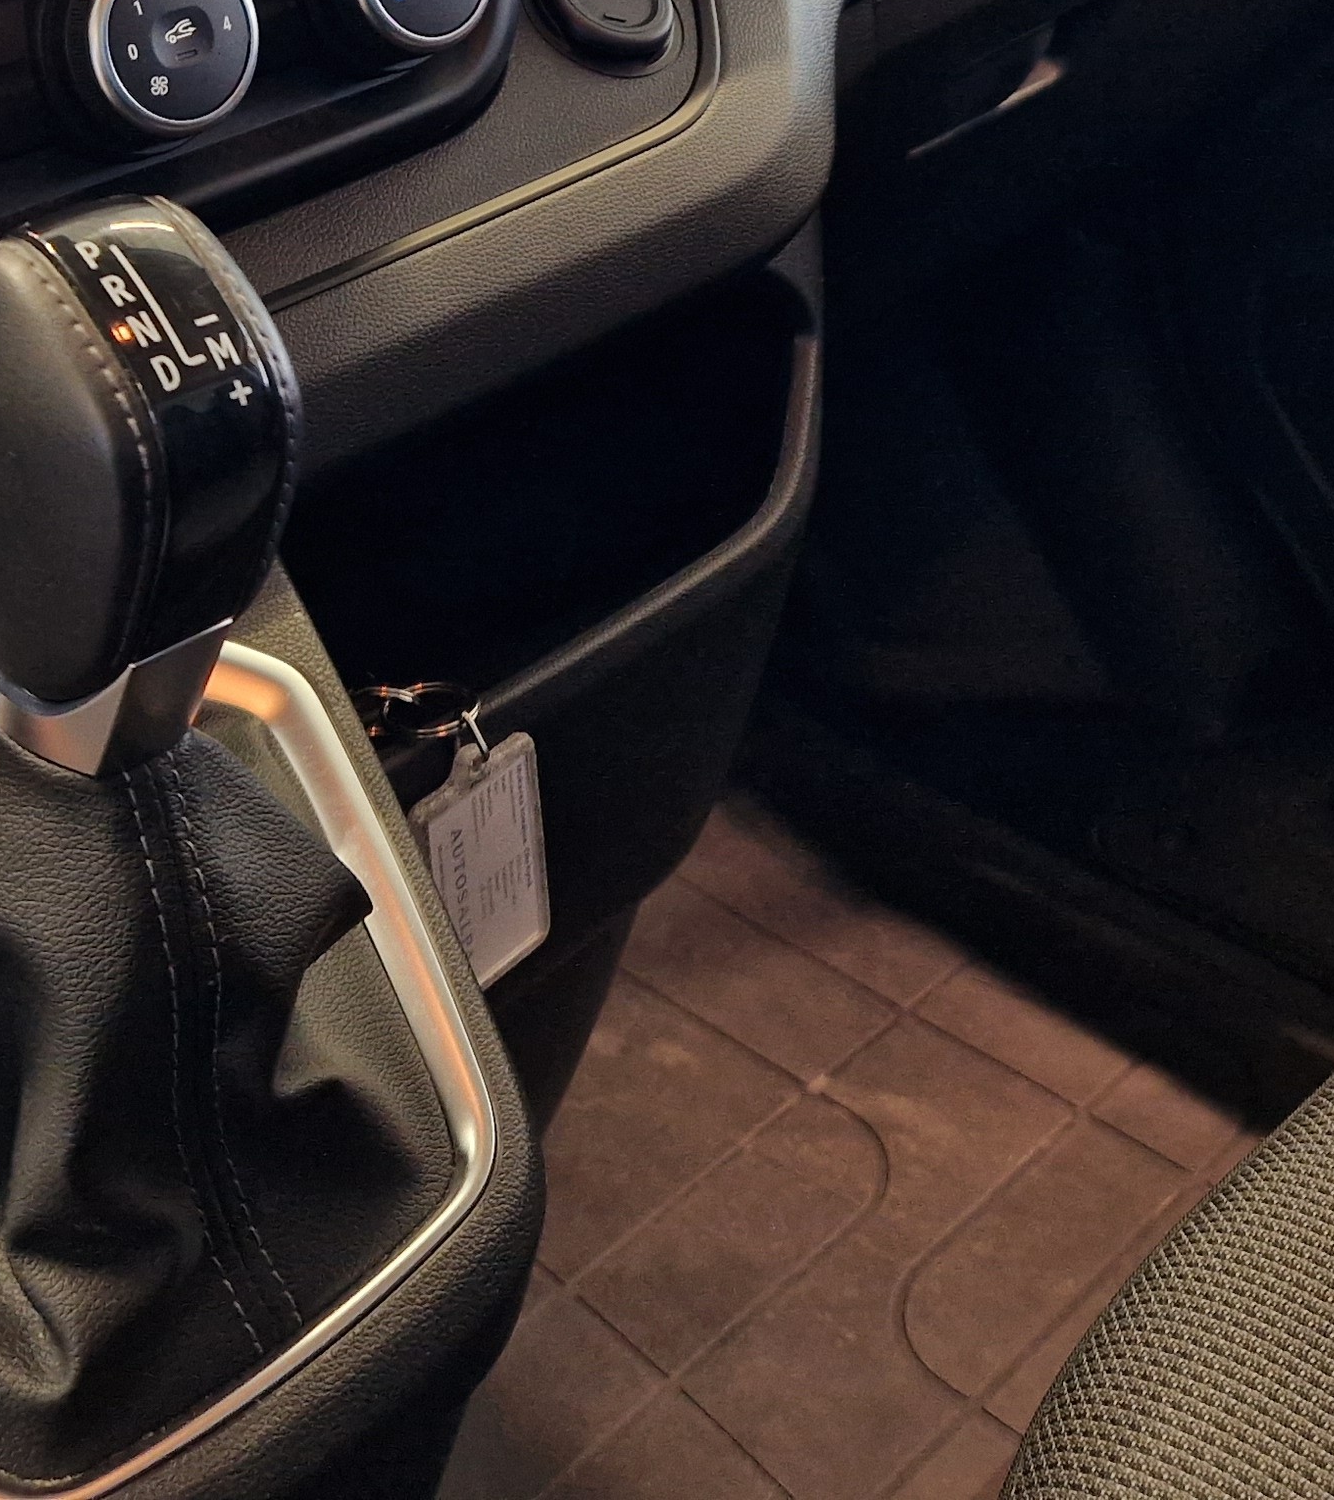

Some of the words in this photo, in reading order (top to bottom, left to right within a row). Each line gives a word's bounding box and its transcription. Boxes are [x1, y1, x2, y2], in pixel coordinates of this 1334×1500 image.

[133, 0, 144, 16] 1
[223, 15, 232, 32] 4
[127, 43, 139, 60] 0
[74, 240, 101, 270] P
[99, 274, 137, 307] R
[125, 311, 163, 348] N
[204, 331, 243, 371] M
[149, 354, 182, 392] D
